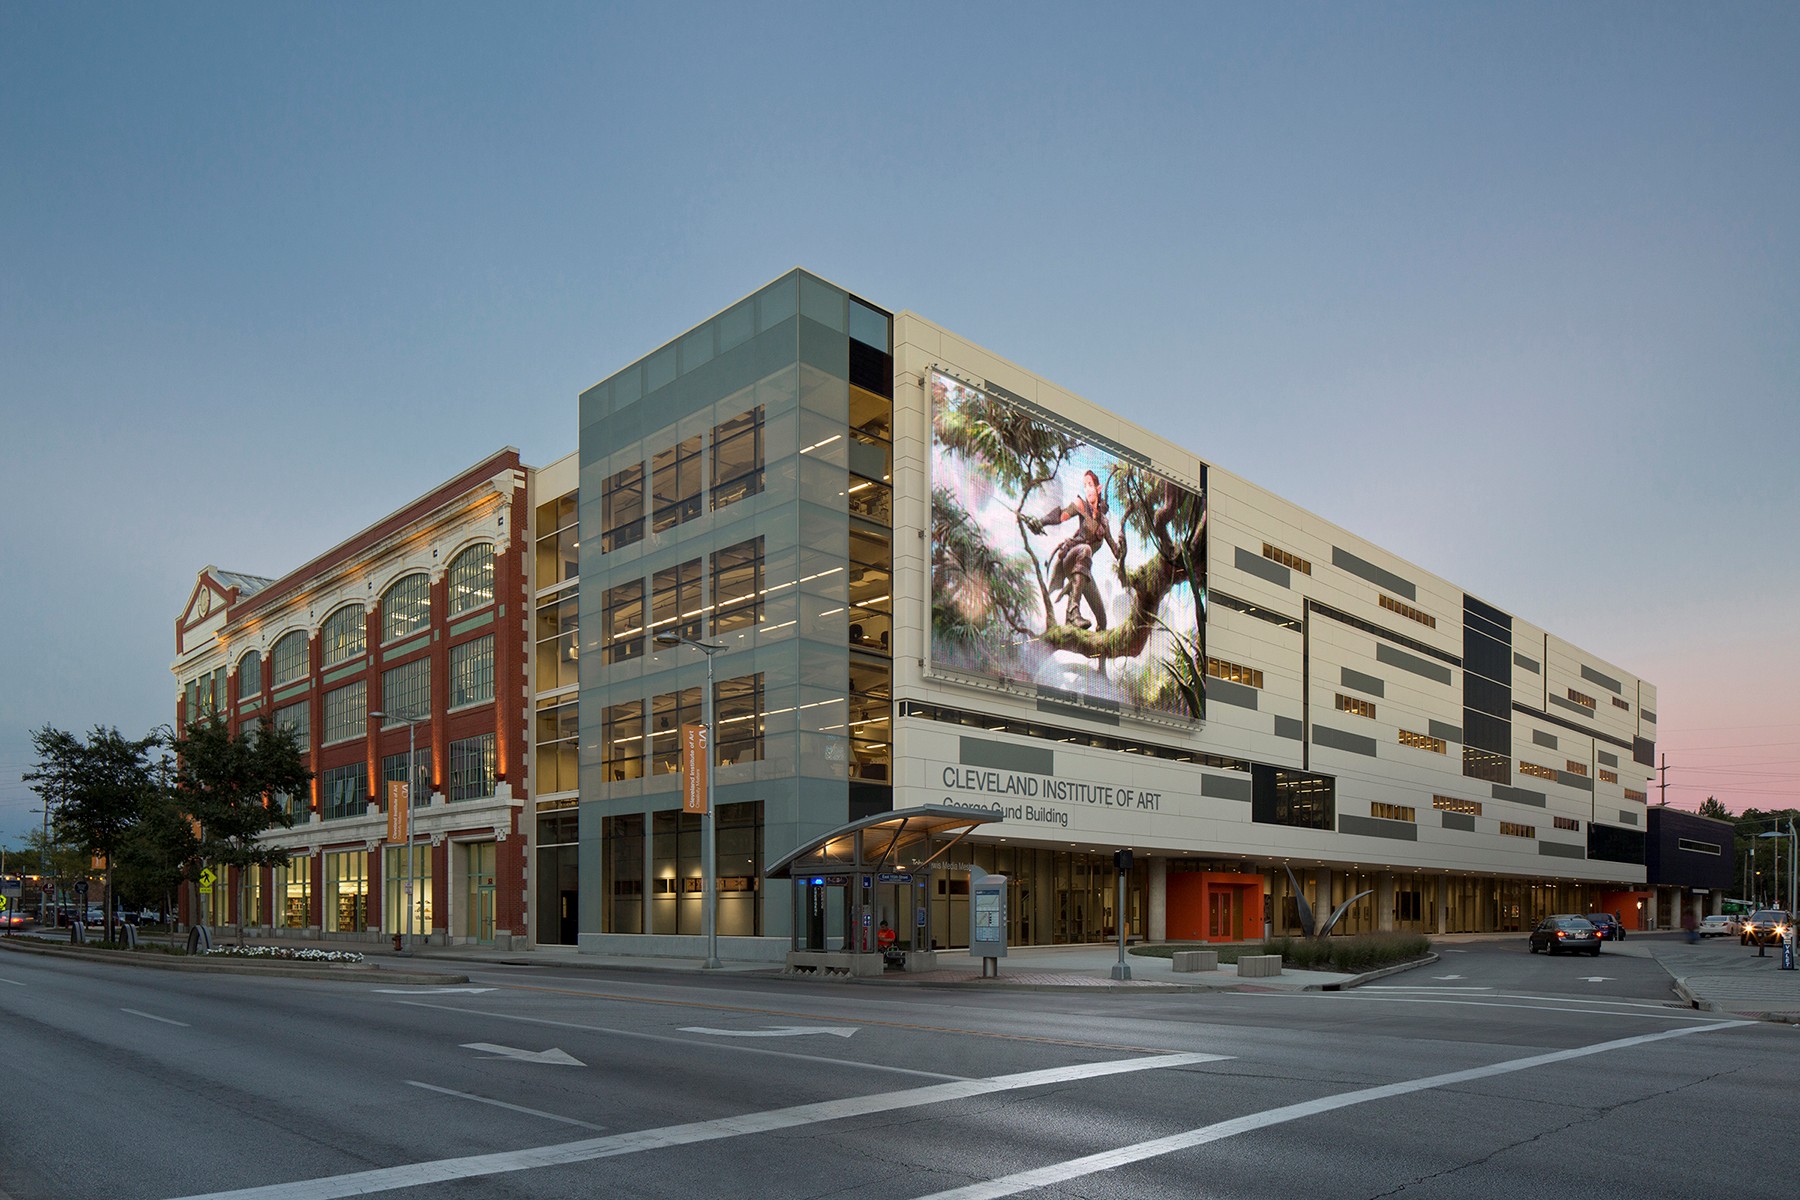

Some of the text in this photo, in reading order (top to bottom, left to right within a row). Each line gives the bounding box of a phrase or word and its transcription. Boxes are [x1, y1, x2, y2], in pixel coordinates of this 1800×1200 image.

[943, 767, 1161, 810] CLEVELAND INSTITUTE OF ART
[991, 802, 1022, 819] Gund
[1026, 805, 1068, 827] Building
